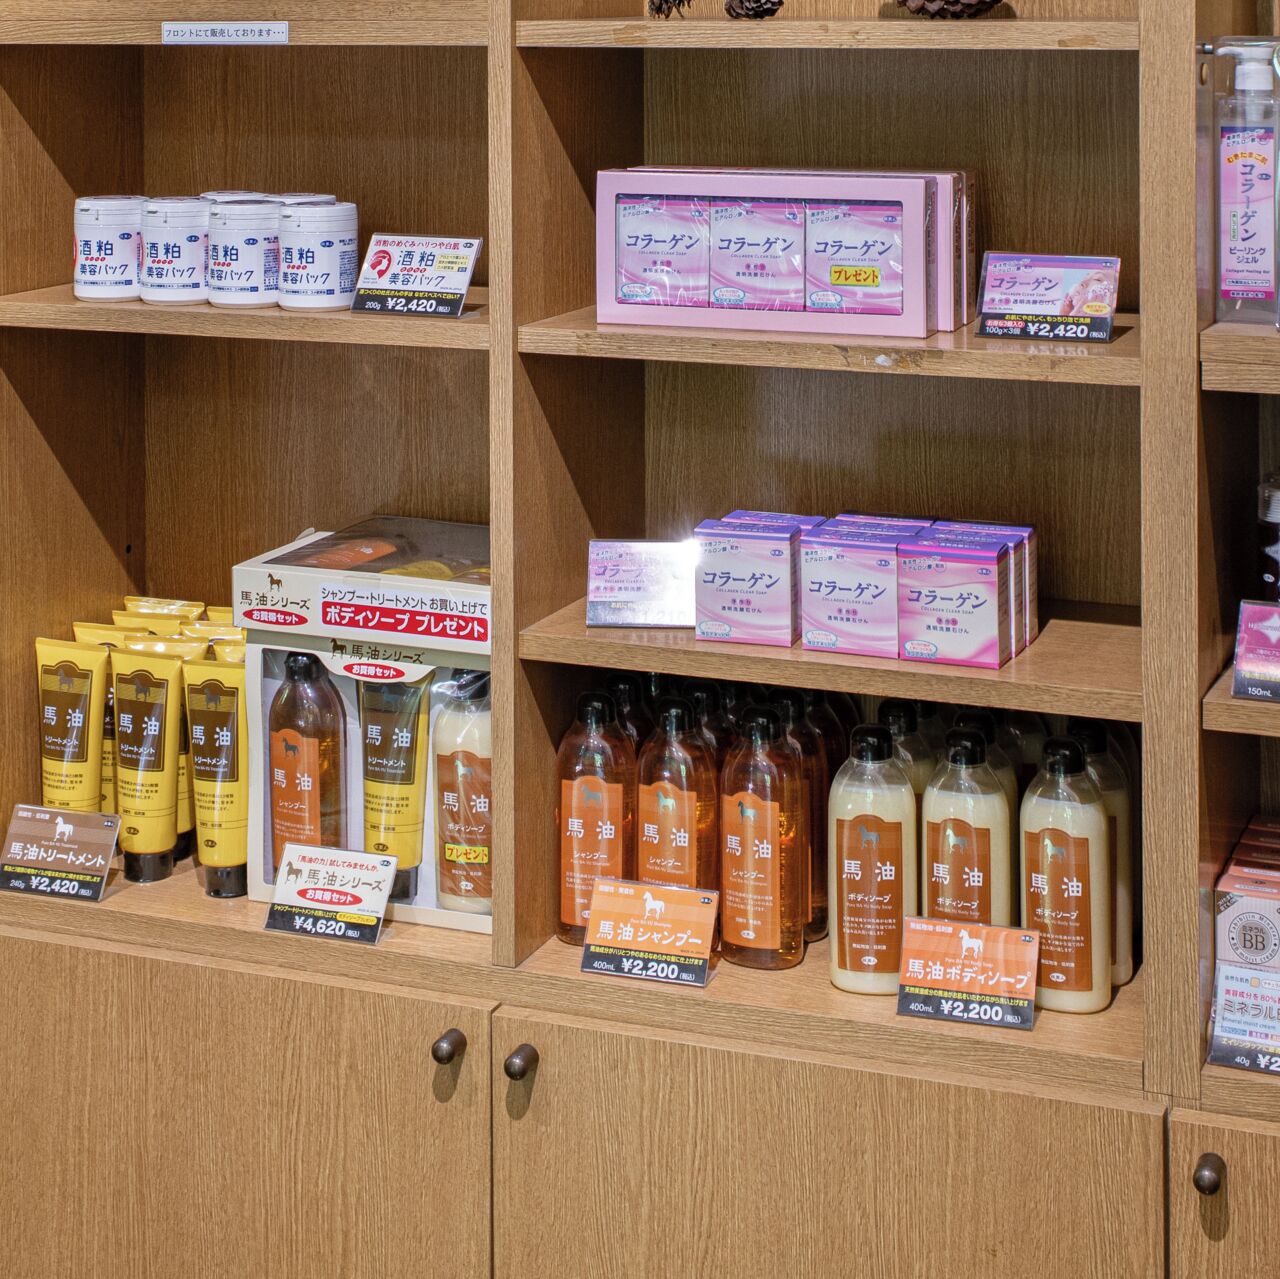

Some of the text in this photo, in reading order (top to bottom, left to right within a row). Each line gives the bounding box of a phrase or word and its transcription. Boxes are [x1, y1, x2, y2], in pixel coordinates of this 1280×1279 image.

[1240, 164, 1257, 242] コラーゲン
[80, 240, 113, 256] 酒粕
[147, 242, 180, 258] 酒粕
[626, 234, 699, 250] コラーゲン
[718, 238, 794, 254] コラーゲン
[815, 240, 893, 256] コラーゲン
[210, 245, 239, 261] 酒粕
[282, 247, 314, 264] 酒粕
[397, 251, 436, 266] 酒粕
[1236, 256, 1259, 264] ジェル
[80, 264, 128, 276] 美容パック
[210, 269, 254, 282] 美容パック
[833, 269, 878, 283] プレゼント
[388, 273, 445, 286] 美容パック
[991, 277, 1059, 291] コラーゲン
[386, 298, 436, 312] ¥2,420
[1027, 323, 1088, 338] ¥2,420
[703, 572, 780, 589] コラーゲン
[809, 579, 887, 598] コラーゲン
[240, 591, 310, 610] 馬油シリーズ
[322, 588, 487, 615] シャンプー・トリートメント お買い上げで
[908, 590, 987, 609] コラーゲン
[252, 610, 298, 623] お買得セット
[326, 606, 485, 638] ボディソープ プレゼント
[350, 645, 425, 664] 馬油シリーズ
[1247, 687, 1272, 696] 150mL
[44, 706, 83, 727] 馬油
[120, 713, 159, 735] 馬油
[46, 736, 78, 745] トリートメント
[192, 725, 231, 746] 馬油
[367, 725, 410, 748] 馬油
[274, 768, 311, 791] 馬油
[280, 801, 307, 809] シャンプー
[444, 792, 488, 813] 馬油
[448, 823, 485, 832] ボディソープ
[567, 818, 615, 839] 馬油
[643, 824, 689, 847] 馬油
[8, 842, 106, 867] 馬油トリートメント
[448, 846, 487, 862] プレゼント
[726, 835, 771, 858] 馬油
[574, 851, 607, 860] シャンプー
[843, 860, 895, 881] 馬油
[932, 864, 983, 887] 馬油
[10, 876, 78, 894] 240g ¥2,420
[305, 869, 385, 892] 馬油シリーズ
[1031, 873, 1082, 897] 馬油
[848, 894, 891, 903] ボディソープ
[294, 916, 345, 935] ¥4,620
[597, 920, 702, 946] 馬油シャンプー
[1242, 926, 1265, 934] ミネラル
[1260, 916, 1277, 941] Mineral
[1243, 933, 1265, 950] BB
[593, 958, 678, 978] 400mL ¥2,200
[906, 959, 1032, 988] 馬油ボディソープ
[941, 1000, 1002, 1021] ¥2,200
[1235, 1056, 1250, 1066] 40g
